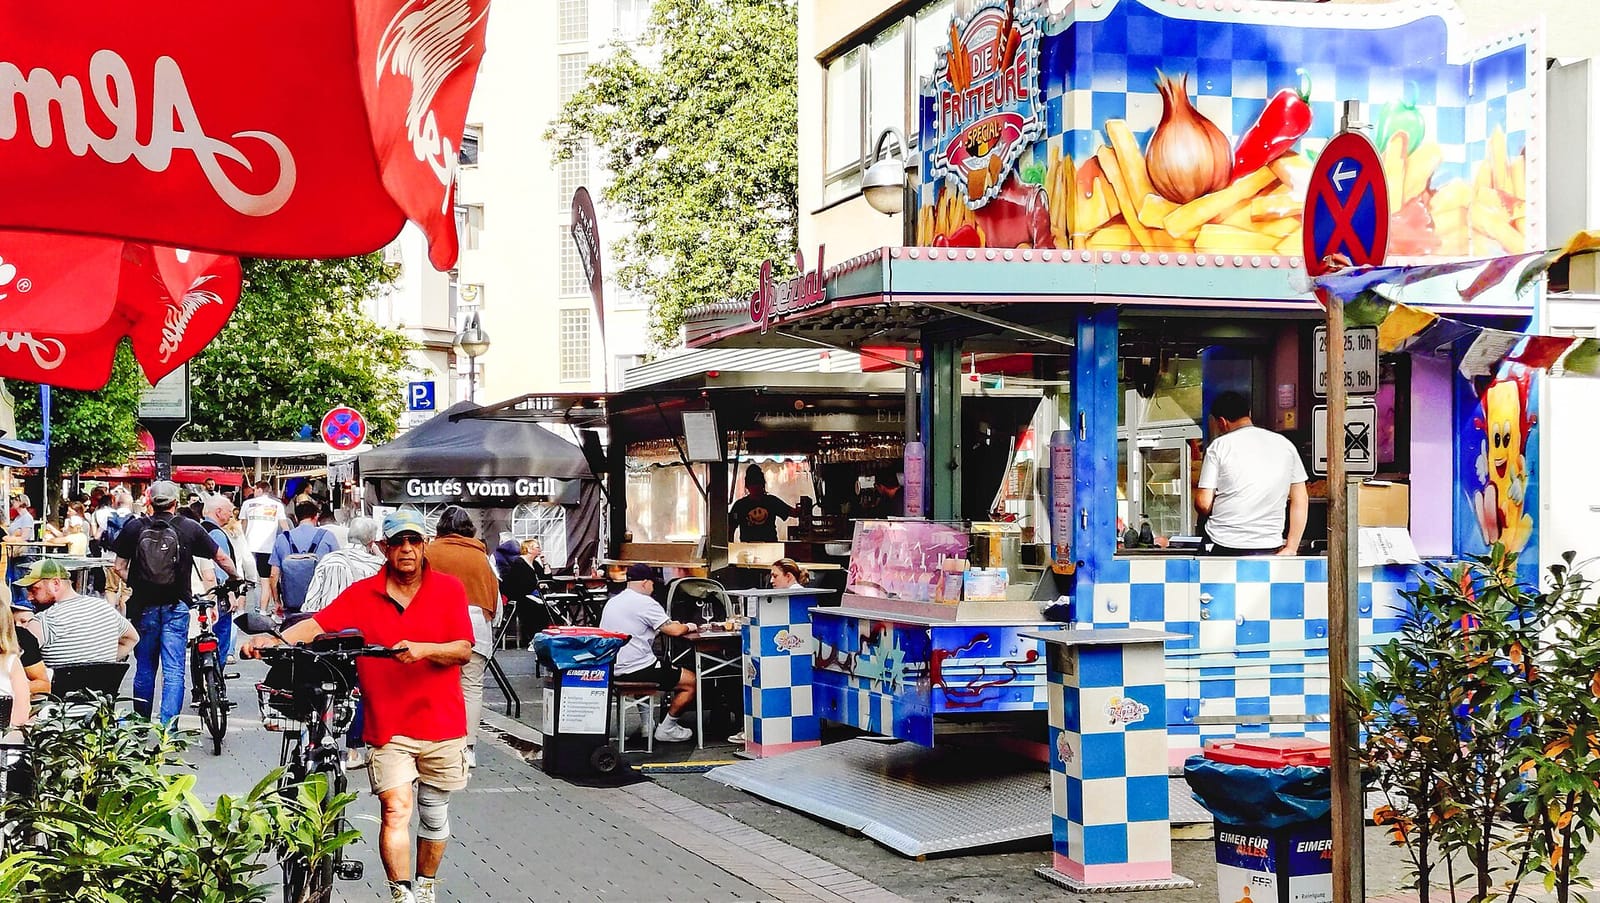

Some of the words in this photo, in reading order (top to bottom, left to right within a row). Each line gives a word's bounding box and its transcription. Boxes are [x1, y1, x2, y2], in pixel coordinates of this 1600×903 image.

[972, 50, 993, 79] DIE
[941, 51, 1029, 136] FRITTEURE
[749, 242, 827, 335] Spezial
[1357, 334, 1372, 351] 10h
[1357, 369, 1372, 386] 18h
[412, 384, 428, 408] P
[406, 478, 462, 497] Gutes
[467, 481, 511, 496] vom
[515, 476, 556, 496] Grill
[1219, 832, 1247, 846] EIMER
[1248, 836, 1269, 849] FÜR
[1296, 839, 1333, 853] EIMER
[1320, 850, 1333, 860] AL
